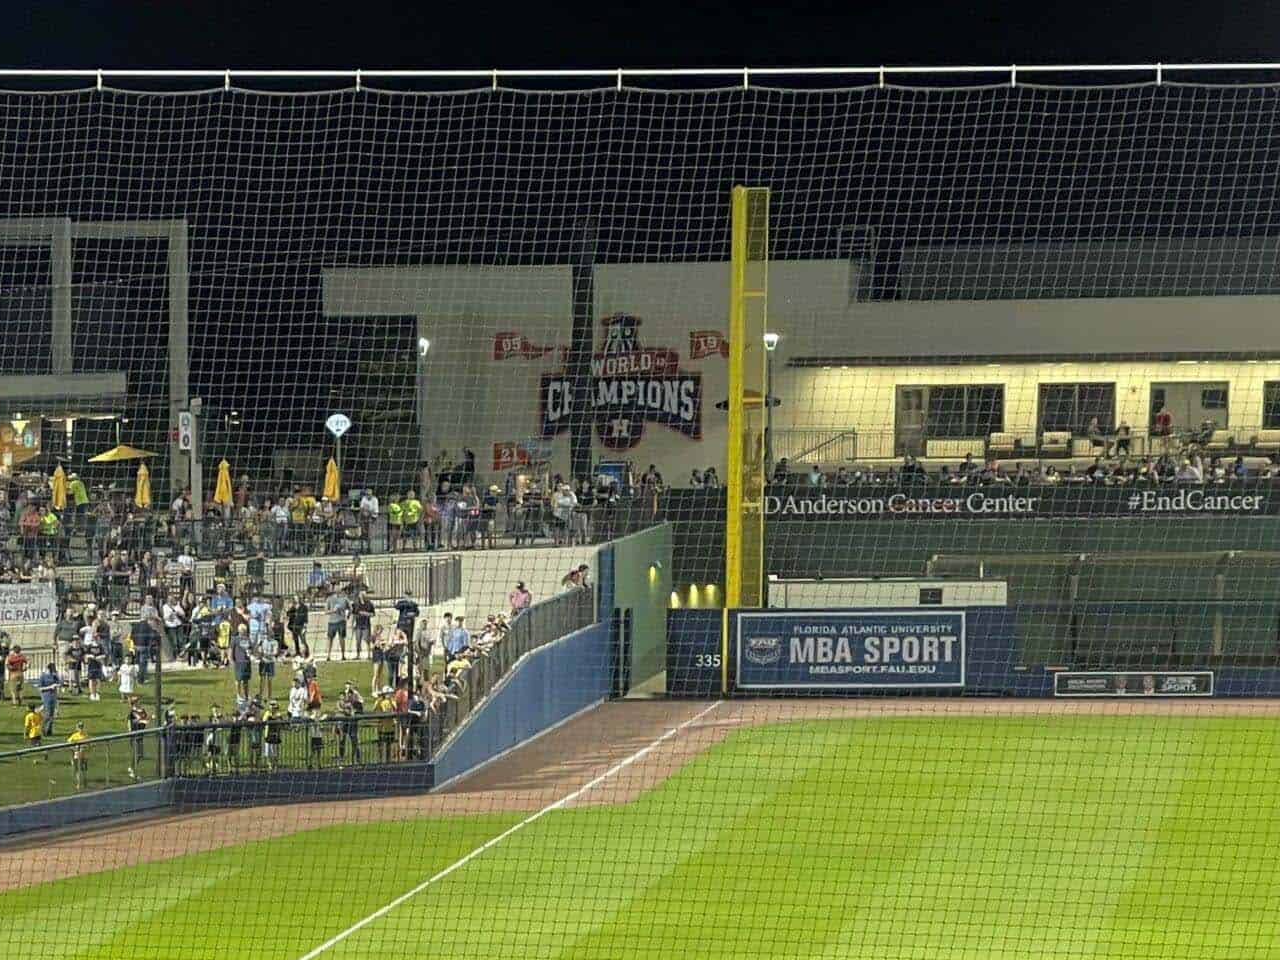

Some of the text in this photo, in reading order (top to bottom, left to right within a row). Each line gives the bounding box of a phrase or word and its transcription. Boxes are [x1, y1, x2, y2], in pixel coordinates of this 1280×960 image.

[591, 354, 652, 376] WORLD
[888, 494, 966, 513] Cancer
[967, 493, 1036, 512] Center
[1128, 489, 1263, 511] #EndCancer
[16, 608, 49, 621] PATIO
[794, 624, 953, 634] FLORIDA ATLANTIC UNIVERSITY
[789, 636, 957, 664] MBA SPORT
[695, 654, 721, 668] 335
